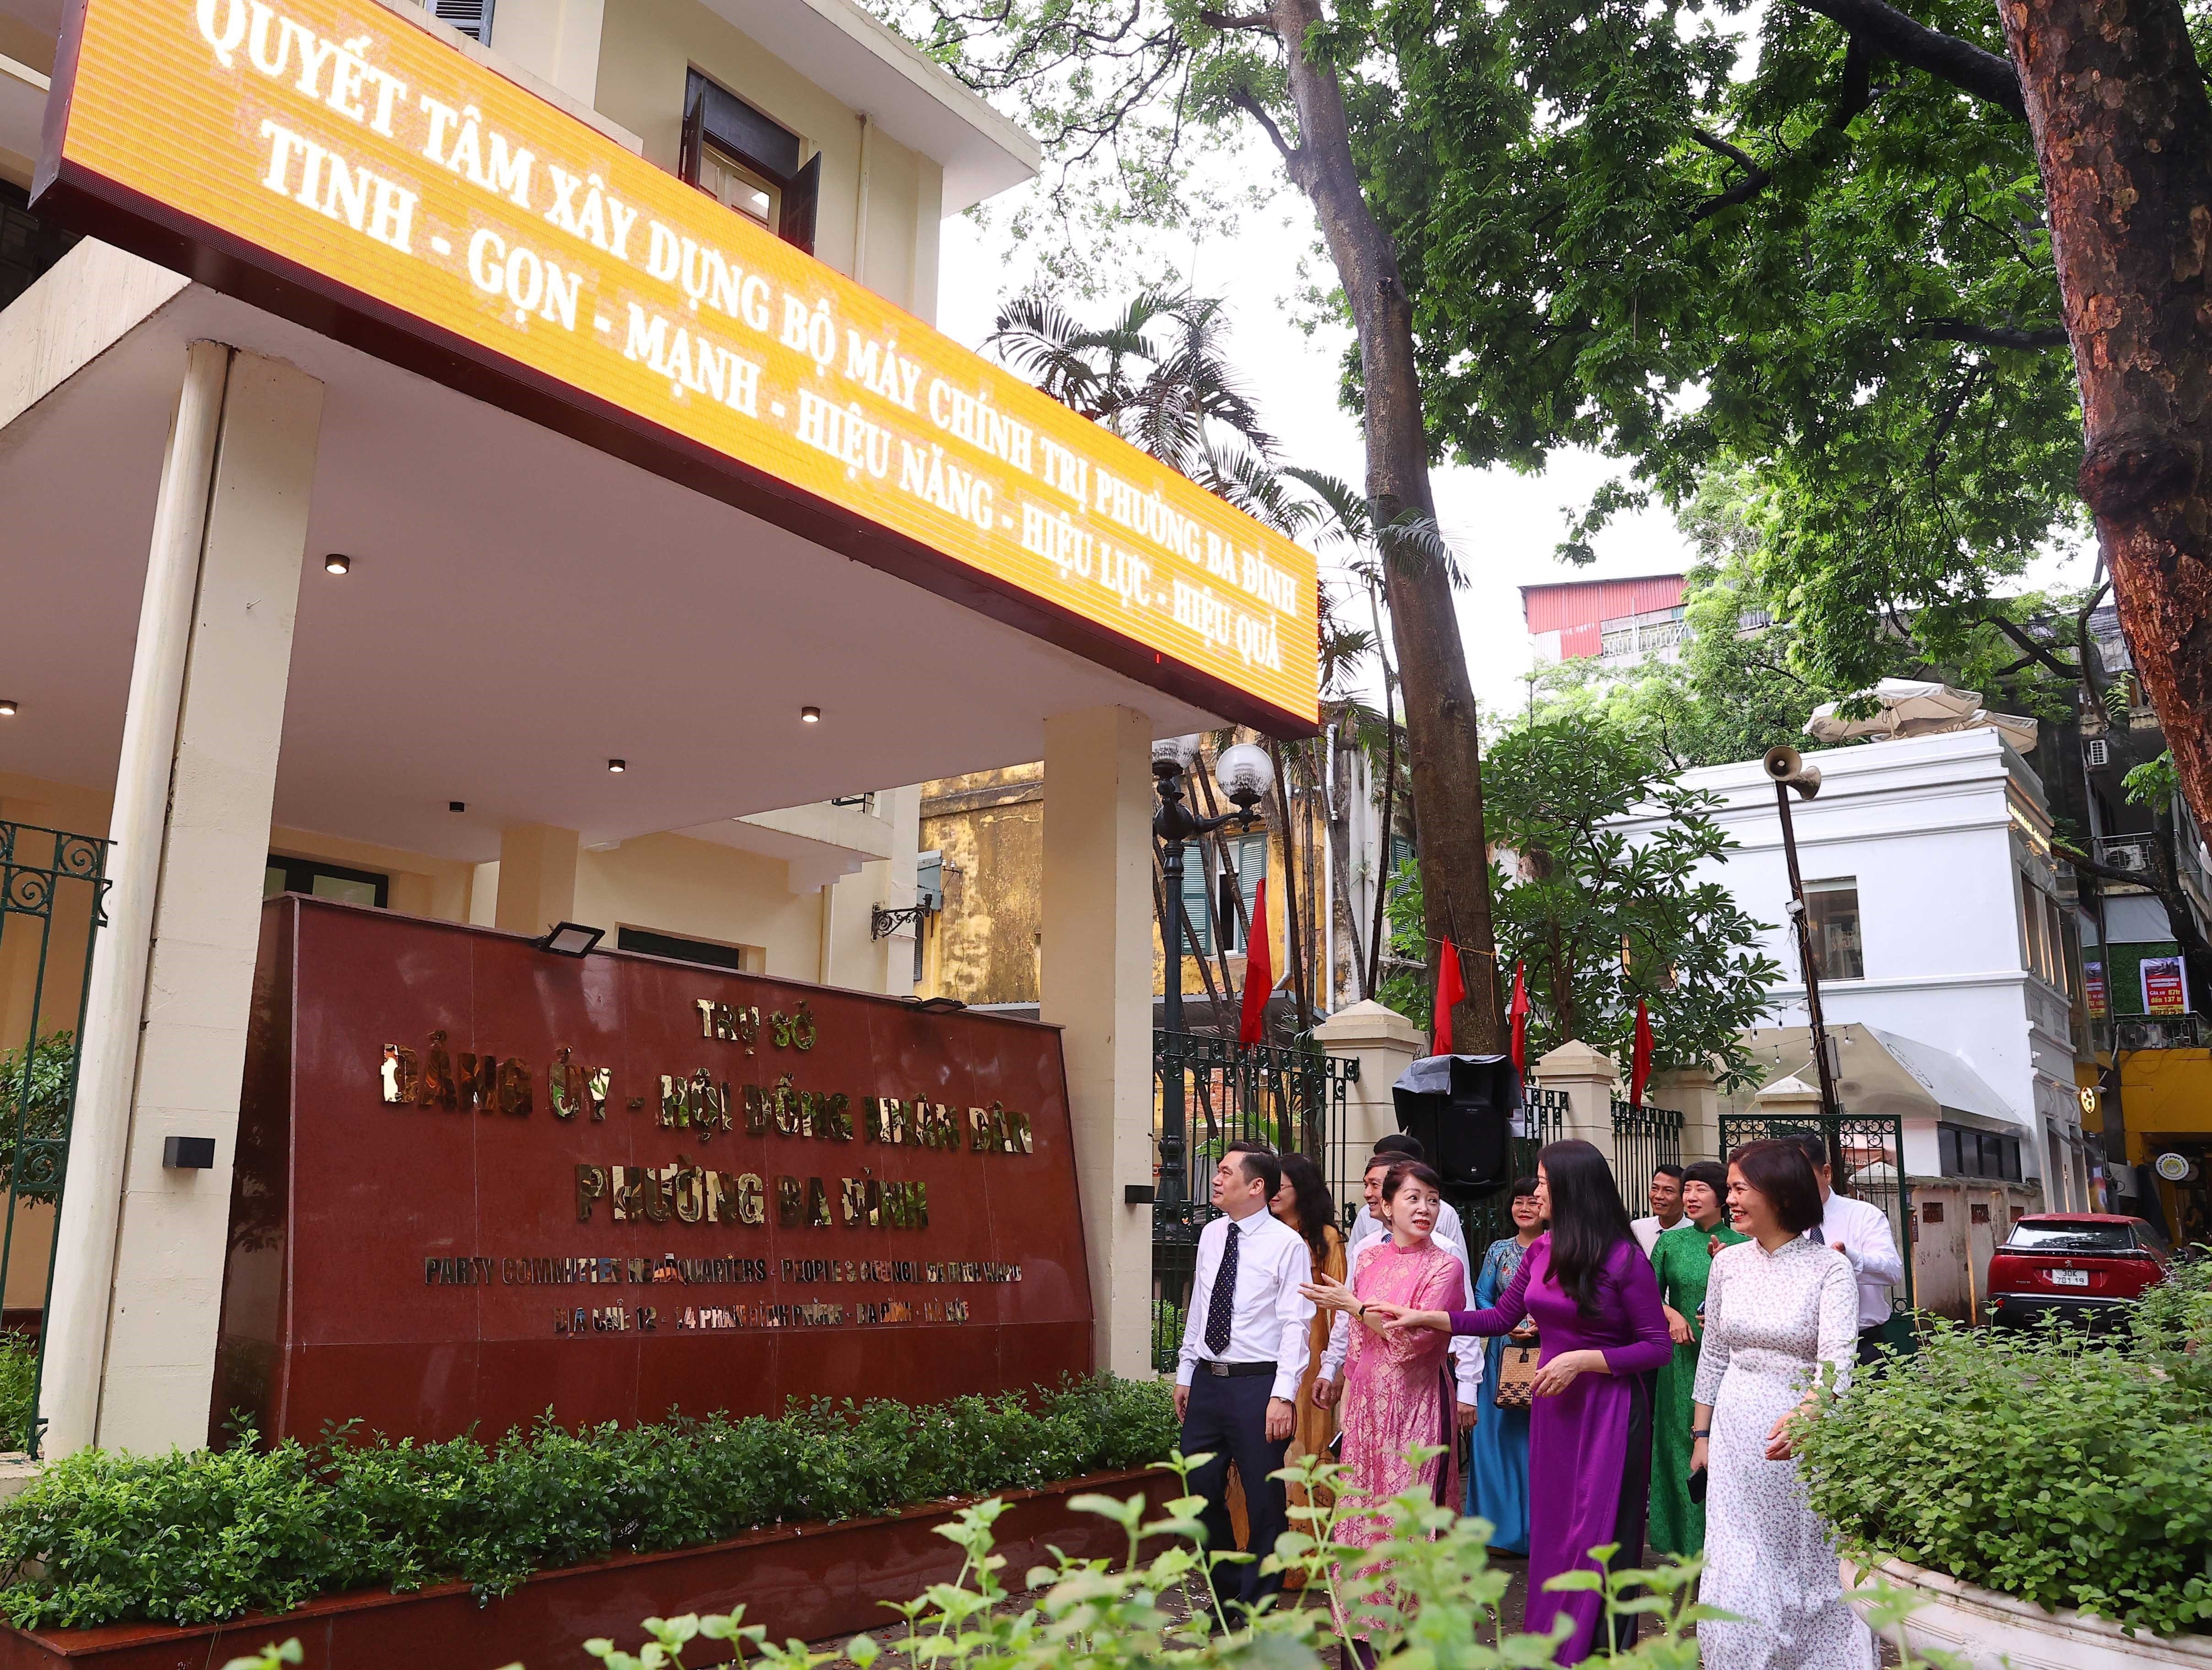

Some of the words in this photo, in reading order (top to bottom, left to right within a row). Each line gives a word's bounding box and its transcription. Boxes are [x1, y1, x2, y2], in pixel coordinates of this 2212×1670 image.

[197, 0, 407, 137] QUYẾT
[419, 95, 535, 209] TÂM
[544, 165, 638, 260] XÂY
[645, 220, 770, 331] DỰNG
[780, 293, 837, 376] BỘ
[844, 329, 922, 412] MÁY
[929, 379, 1033, 473] CHÍNH
[1040, 437, 1088, 513] TRỊ
[1095, 468, 1200, 563] PHƯỜNG
[1206, 531, 1237, 584] BA
[1242, 551, 1296, 616] ĐÌNH
[260, 119, 418, 254] TINH
[468, 228, 583, 331] GỌN
[624, 302, 760, 418] MẠNH
[796, 388, 892, 479] HIỆU
[899, 439, 993, 529] NĂNG
[1021, 502, 1093, 579] HIỆU
[1100, 542, 1151, 607] LỰC
[1173, 580, 1231, 647] HIỆU
[1236, 613, 1281, 672] QUẢ
[696, 998, 760, 1055] TRỤ
[764, 999, 817, 1050] SỞ
[381, 1030, 532, 1114] ĐẢNG
[656, 1068, 732, 1141] HỘI
[743, 1072, 854, 1140] ĐỒNG
[576, 1154, 764, 1224] PHƯỜNG
[777, 1175, 832, 1226] BA
[840, 1167, 929, 1228] ĐÌNH
[425, 1257, 494, 1284] PARTY
[860, 1260, 924, 1283] COUNCIL
